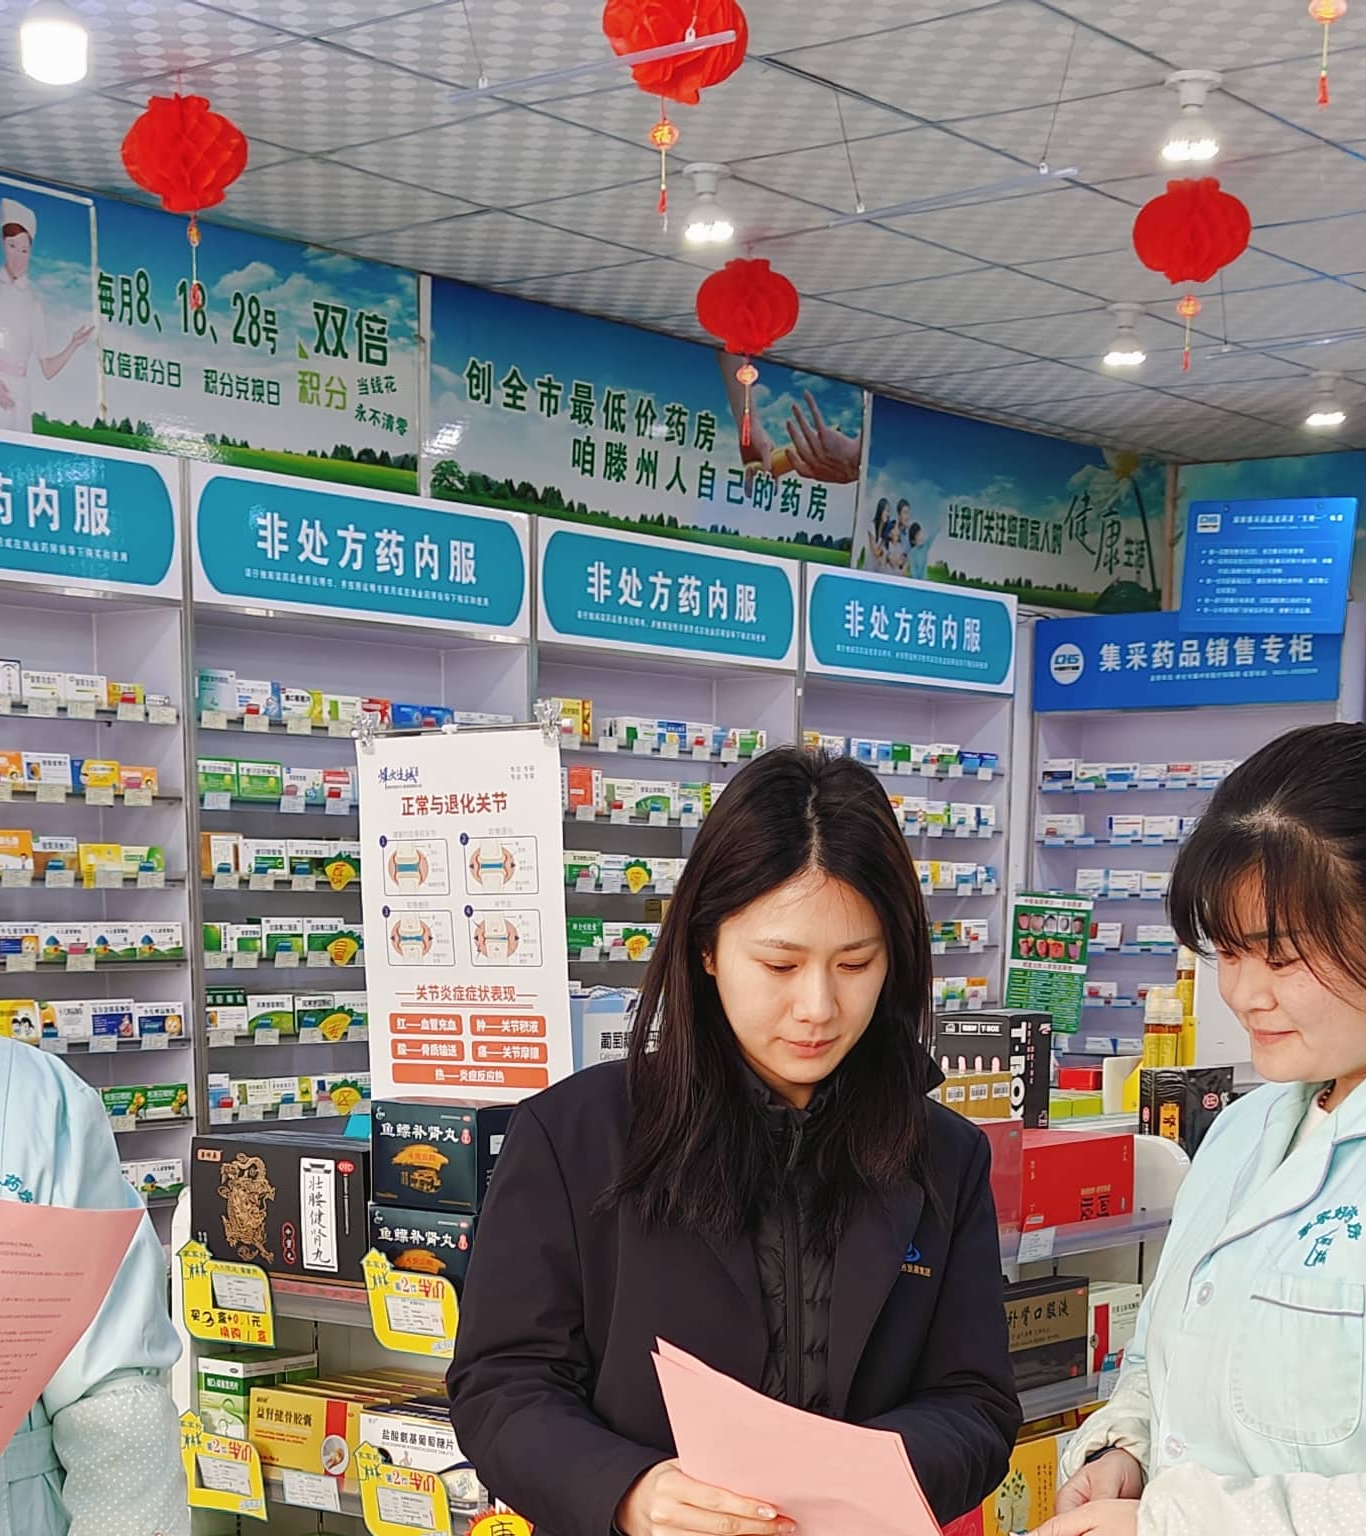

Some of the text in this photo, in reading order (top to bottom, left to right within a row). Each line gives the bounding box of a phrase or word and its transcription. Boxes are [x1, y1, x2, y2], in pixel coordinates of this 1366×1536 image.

[312, 300, 388, 367] 双倍
[102, 349, 182, 390] 双倍积分日
[203, 368, 280, 407] 积分兑换日
[356, 373, 397, 397] 当钱花
[298, 369, 348, 411] 积分
[464, 356, 717, 453] 创全市最低价药房
[355, 403, 408, 438] 永不清零
[571, 434, 827, 522] 咱滕州人自己的药房
[256, 511, 477, 585] 非处方药内服
[586, 560, 757, 624] 非处方药内服
[843, 599, 982, 653] 非处方药内服
[1098, 633, 1315, 673] 集采药品销售专柜
[401, 792, 508, 817] 正常与退化关节
[415, 984, 516, 1002] 关节炎症症状表现
[379, 1121, 459, 1144] 鱼鳔补肾丸
[308, 1175, 331, 1264] 壮腰健肾丸
[377, 1227, 457, 1249] 鱼鳔补肾丸
[255, 1405, 314, 1428] 益肾健骨胶囊
[381, 1428, 456, 1450] 盐酸氨基葡萄糖片
